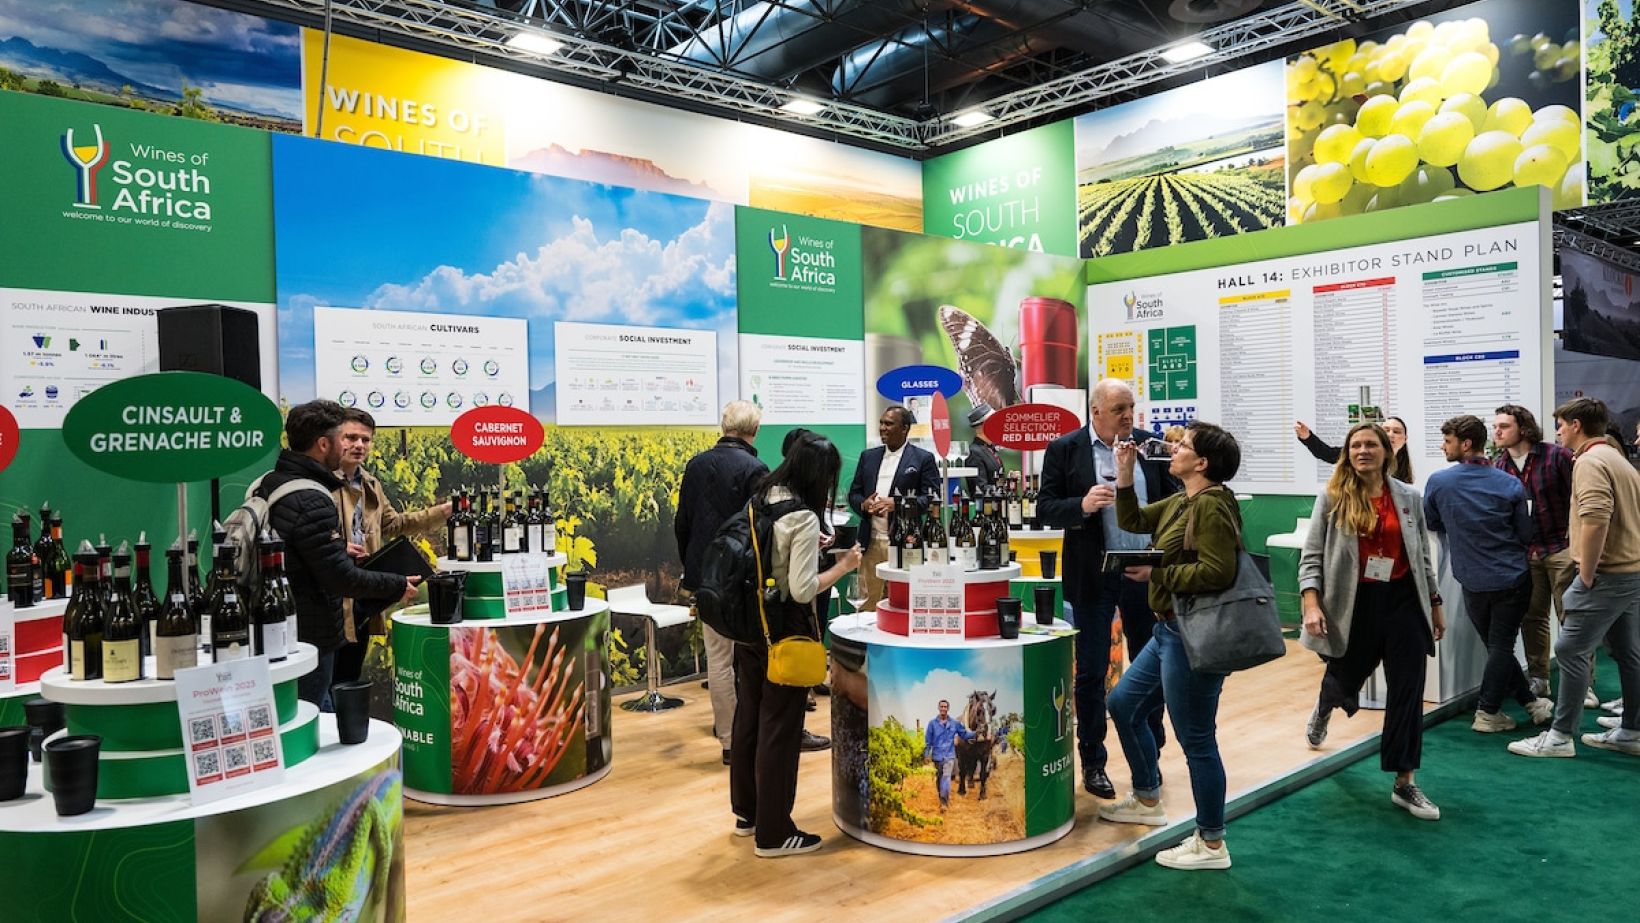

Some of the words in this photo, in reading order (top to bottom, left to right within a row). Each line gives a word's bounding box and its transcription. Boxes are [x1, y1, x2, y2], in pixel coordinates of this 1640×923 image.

[327, 84, 437, 127] WINES
[448, 108, 489, 136] OF
[130, 143, 185, 164] Wines
[190, 152, 209, 166] of
[112, 160, 210, 194] South
[949, 175, 1010, 205] WINES
[1016, 167, 1042, 188] OF
[111, 187, 212, 220] Africa
[62, 210, 104, 222] welcome
[105, 214, 116, 222] to
[117, 216, 132, 225] our
[135, 218, 159, 227] world
[161, 219, 171, 228] of
[172, 220, 213, 233] discovery
[952, 195, 1040, 239] SOUTH
[798, 235, 824, 249] Wines
[825, 239, 834, 249] of
[790, 247, 835, 268] South
[1217, 275, 1255, 289] HALL
[1263, 272, 1284, 284] 14:
[1291, 257, 1382, 281] EXHIBITOR
[1391, 246, 1453, 268] STAND
[1463, 237, 1518, 257] PLAN
[790, 265, 836, 285] Africa
[12, 302, 44, 312] SOUTH
[46, 303, 87, 313] AFRICAN
[90, 305, 120, 315] WINE
[1136, 298, 1163, 310] South
[1136, 308, 1164, 319] Africa
[430, 324, 480, 335] CULTIVARS
[619, 335, 646, 343] SOCIAL
[647, 336, 692, 345] INVESTMENT
[788, 344, 809, 352] SOCIAL
[810, 345, 846, 353] INVESTMENT
[901, 380, 940, 389] GLASSES
[122, 406, 226, 425] CINSAULT
[230, 406, 242, 424] &
[1005, 412, 1061, 423] SOMMELIER
[474, 422, 524, 433] CABERNET
[1003, 423, 1054, 432] SELECTION
[89, 430, 211, 453] GRENACHE
[216, 430, 264, 449] NOIR
[472, 435, 527, 446] SAUVIGNON
[1002, 432, 1022, 442] RED
[1024, 432, 1062, 442] BLENDS
[414, 670, 423, 680] of
[235, 679, 256, 691] 2023
[394, 676, 423, 699] South
[394, 693, 424, 716] Africa
